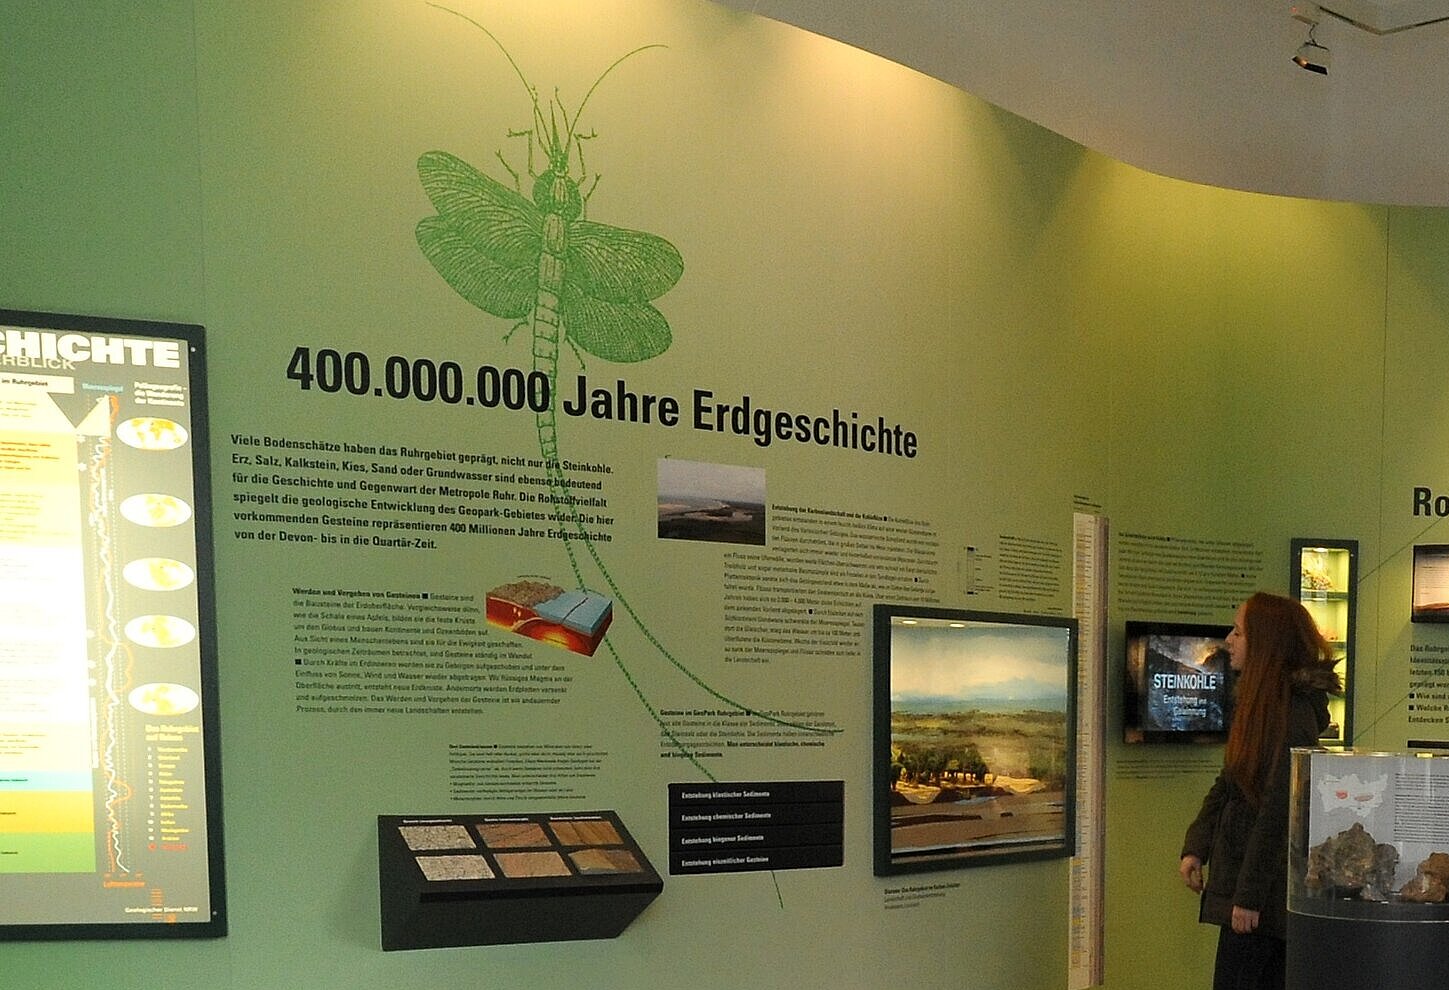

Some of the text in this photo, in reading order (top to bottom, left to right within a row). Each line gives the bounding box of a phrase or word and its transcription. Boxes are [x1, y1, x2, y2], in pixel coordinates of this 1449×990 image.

[0, 330, 180, 368] HICHTE
[286, 346, 918, 459] 400.000.000 Jahre Erdgeschichte
[230, 433, 260, 446] Viele
[263, 436, 340, 452] Bodenschätze
[343, 442, 376, 455] haben
[379, 445, 397, 456] das
[400, 446, 456, 461] Ruhrgebiet
[500, 455, 525, 467] nicht
[527, 459, 543, 468] nur
[546, 459, 560, 469] die
[232, 472, 248, 483] für
[251, 473, 268, 484] die
[271, 474, 334, 488] Geschichte
[336, 480, 356, 490] und
[359, 480, 417, 494] Gegenwart
[419, 484, 436, 495] der
[439, 485, 490, 500] Metropole
[519, 491, 535, 502] Die
[537, 492, 607, 508] Rohstoffvielfalt
[371, 462, 397, 474] Sand
[400, 465, 423, 476] oder
[426, 467, 492, 481] Grundwasser
[494, 472, 515, 483] sind
[518, 474, 552, 487] ebenso
[554, 478, 602, 490] bedeutend
[233, 491, 279, 505] spiegelt
[281, 493, 299, 505] die
[301, 496, 368, 510] geologische
[370, 499, 435, 515] Entwicklung
[437, 503, 456, 515] des
[579, 514, 594, 524] Die
[596, 514, 614, 525] hier
[233, 511, 612, 543] vorkommenden Gesteine repräsentieren 400 Millionen Jahre Erdgeschichte
[234, 531, 254, 539] von
[257, 530, 276, 540] der
[278, 530, 317, 543] Devon-
[320, 533, 337, 544] bis
[340, 533, 350, 544] in
[352, 535, 369, 545] die
[1153, 673, 1217, 690] STEINKOHLE
